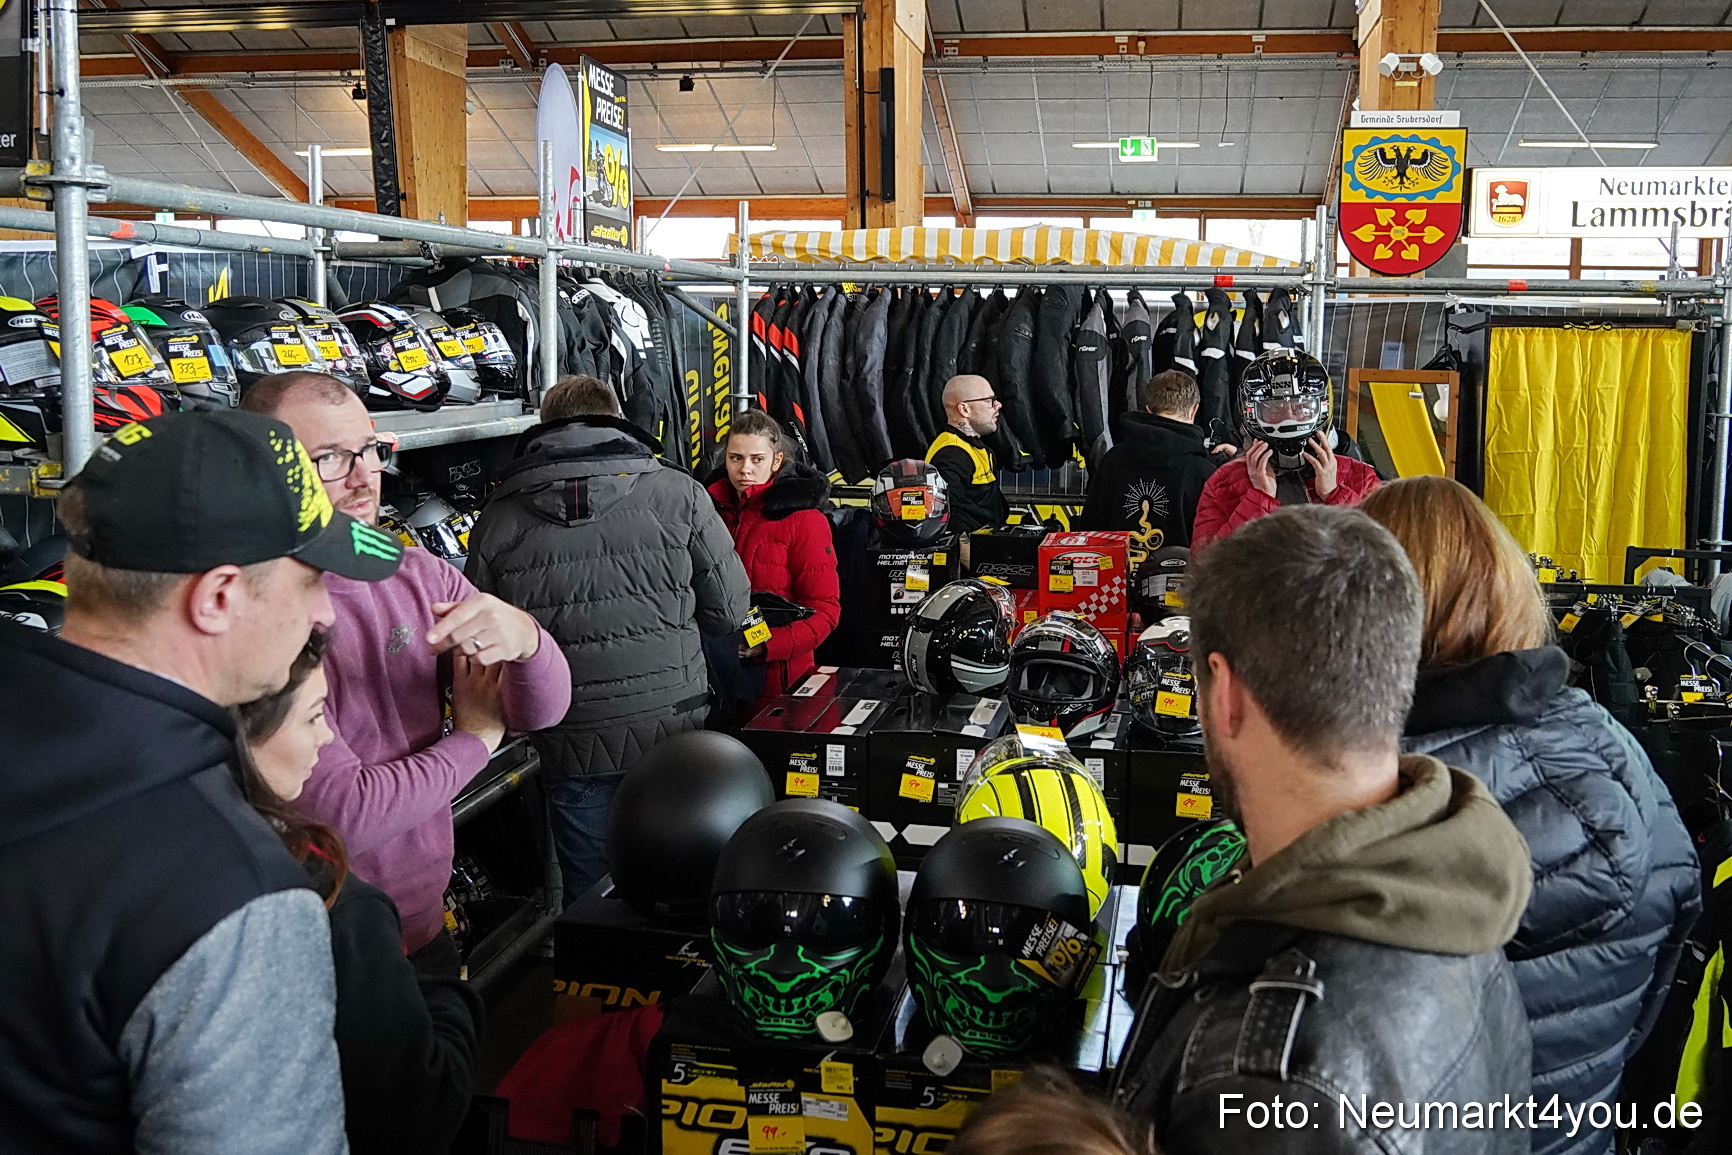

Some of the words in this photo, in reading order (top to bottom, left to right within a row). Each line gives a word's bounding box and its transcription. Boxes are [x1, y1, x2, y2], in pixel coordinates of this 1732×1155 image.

[588, 64, 614, 98] MESSE
[596, 97, 625, 130] PREISE!
[1361, 115, 1394, 124] Gemeinde
[1599, 176, 1732, 196] Neumarkte
[789, 759, 809, 768] MESSE
[1179, 779, 1201, 788] MESSE
[1021, 923, 1044, 959] MESSE
[1035, 918, 1060, 958] PREISE!
[671, 1062, 686, 1083] 5
[748, 1093, 780, 1105] MESSE
[920, 1086, 936, 1107] 5
[768, 1102, 800, 1115] PREIS!
